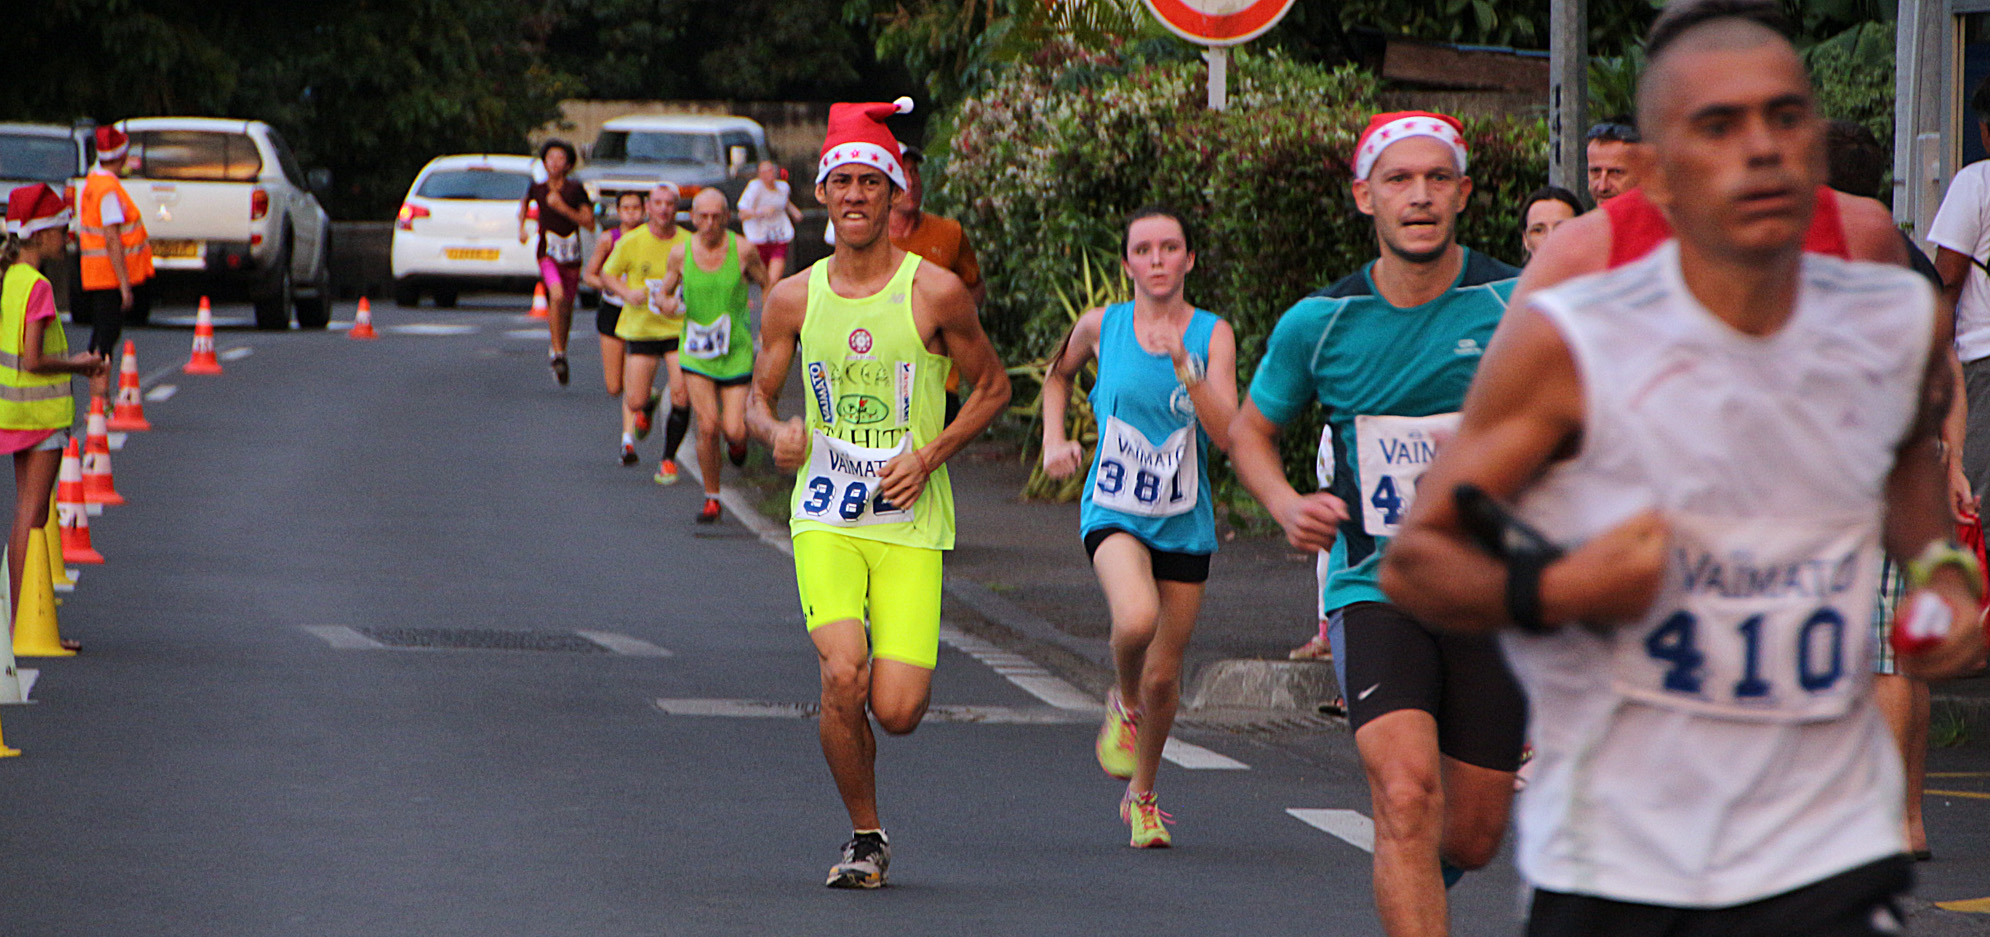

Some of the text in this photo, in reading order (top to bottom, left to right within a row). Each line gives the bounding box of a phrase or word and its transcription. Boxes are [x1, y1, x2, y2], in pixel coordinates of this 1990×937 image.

[823, 425, 909, 449] THIT
[829, 449, 887, 477] VAIMAT
[1097, 459, 1186, 504] 381
[1644, 610, 1845, 699] 410
